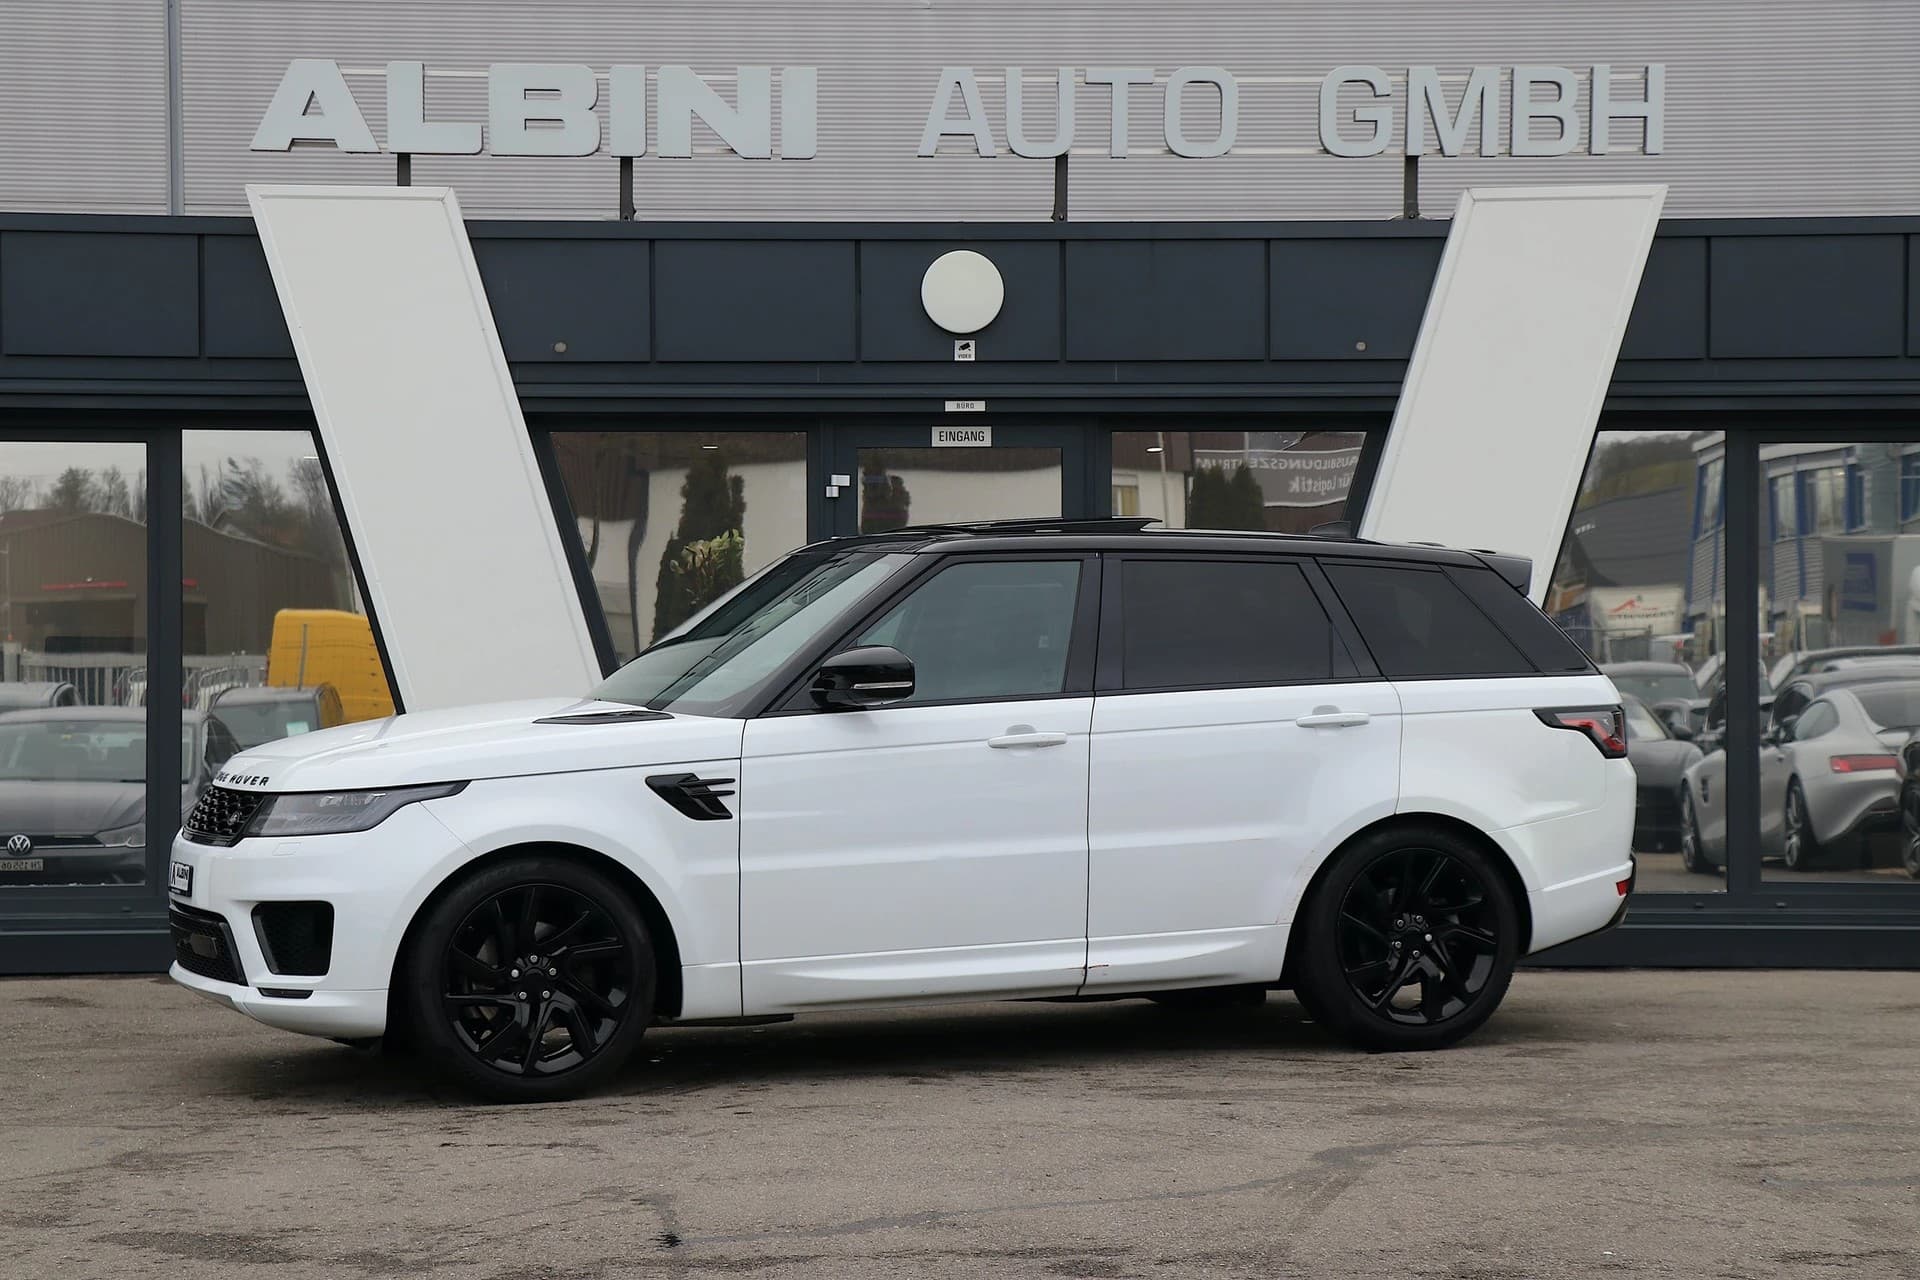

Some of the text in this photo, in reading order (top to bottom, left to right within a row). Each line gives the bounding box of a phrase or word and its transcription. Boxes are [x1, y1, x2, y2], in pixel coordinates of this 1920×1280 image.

[250, 58, 1666, 160] ALBINI AUTO GMBH
[939, 430, 985, 442] EINGANG
[229, 774, 270, 787] ROVER
